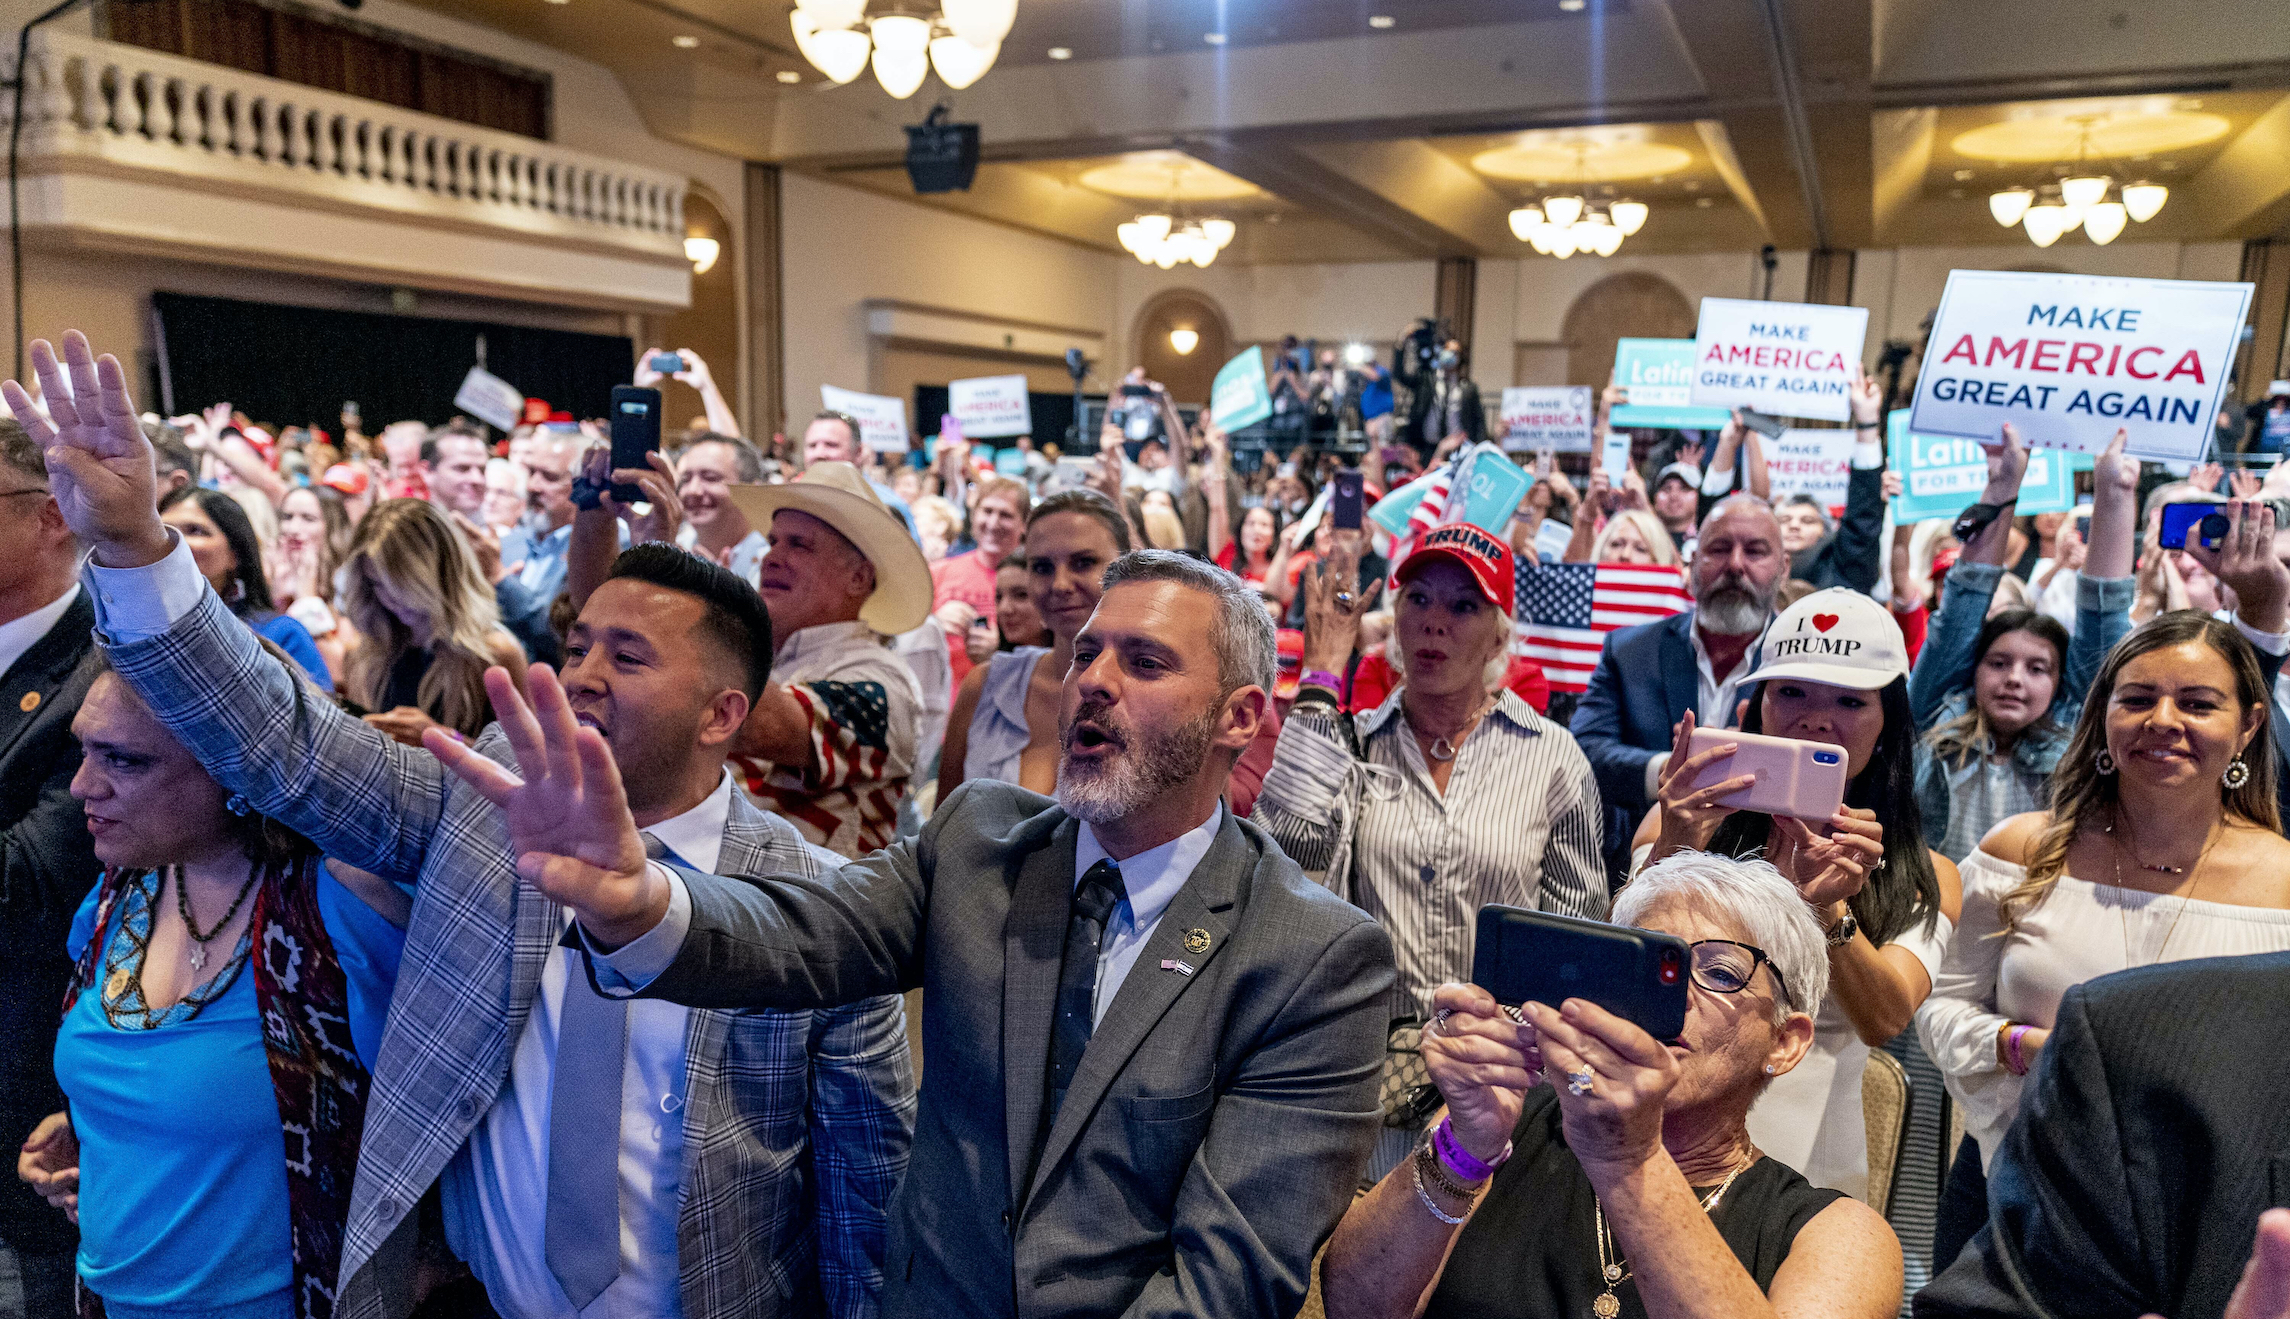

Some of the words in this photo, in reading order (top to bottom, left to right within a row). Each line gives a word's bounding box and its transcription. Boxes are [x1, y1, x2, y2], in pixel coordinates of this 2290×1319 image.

[2026, 304, 2142, 332] MAKE
[1749, 323, 1811, 341] MAKE
[1705, 344, 1845, 373] AMERICA
[1942, 333, 2206, 384] AMERICA
[1700, 370, 1770, 390] GREAT
[1775, 377, 1843, 396] AGAIN
[1932, 377, 2058, 410] GREAT
[2066, 389, 2201, 425] AGAIN
[1766, 459, 1851, 475] MERICA
[1425, 528, 1502, 560] TRUMP
[1796, 617, 1805, 632] I
[1775, 638, 1861, 657] TRUMP
